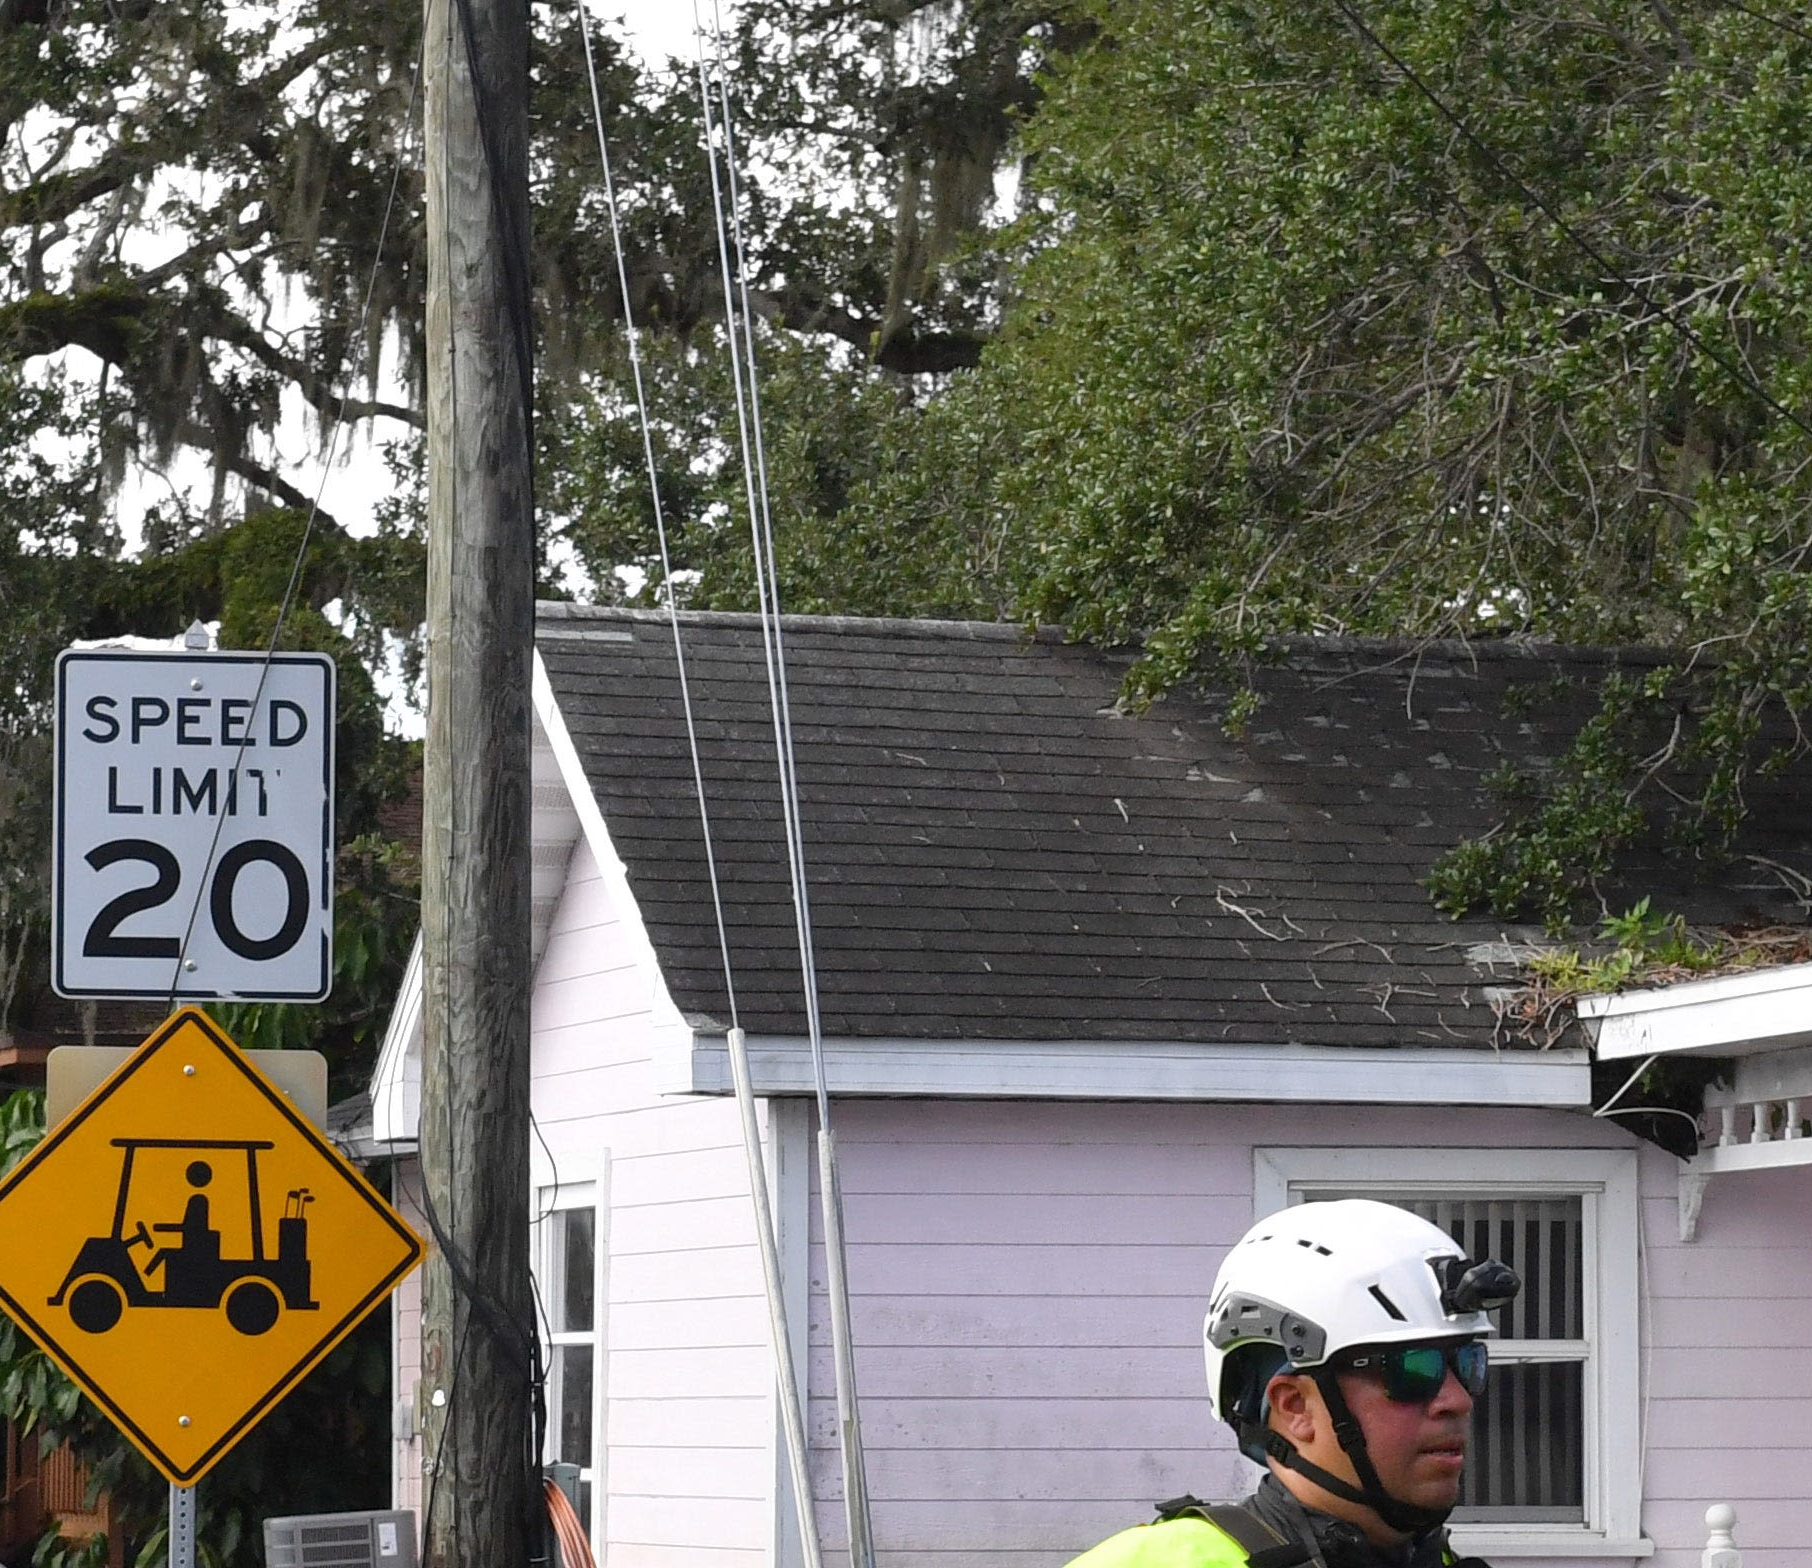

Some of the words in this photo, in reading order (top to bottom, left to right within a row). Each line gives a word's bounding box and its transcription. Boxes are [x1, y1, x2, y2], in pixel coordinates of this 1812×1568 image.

[83, 696, 308, 747] SPEED
[108, 766, 281, 817] LIMIT
[82, 838, 310, 961] 20
